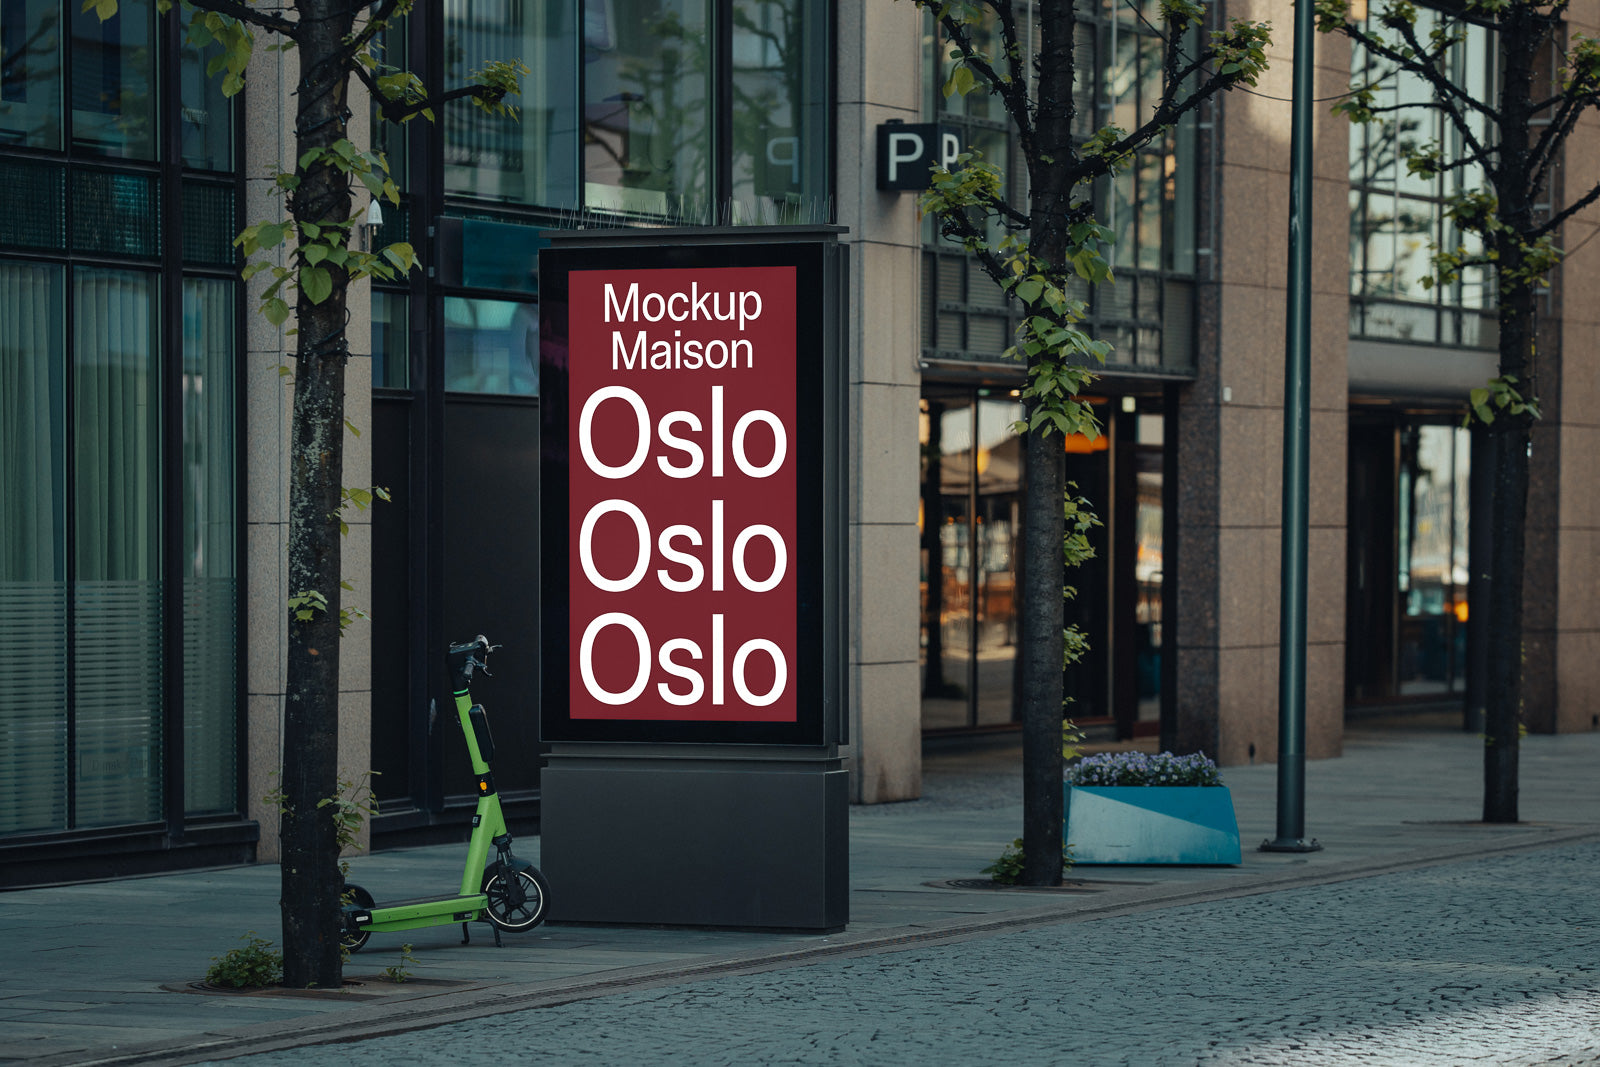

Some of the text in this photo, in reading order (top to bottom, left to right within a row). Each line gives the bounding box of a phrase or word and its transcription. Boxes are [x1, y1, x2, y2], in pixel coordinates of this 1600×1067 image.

[888, 132, 924, 182] P
[942, 133, 960, 174] P
[604, 281, 763, 331] Mockup
[612, 330, 753, 370] Maison
[579, 385, 788, 479] Oslo
[579, 499, 788, 593] Oslo
[579, 613, 788, 707] Oslo
